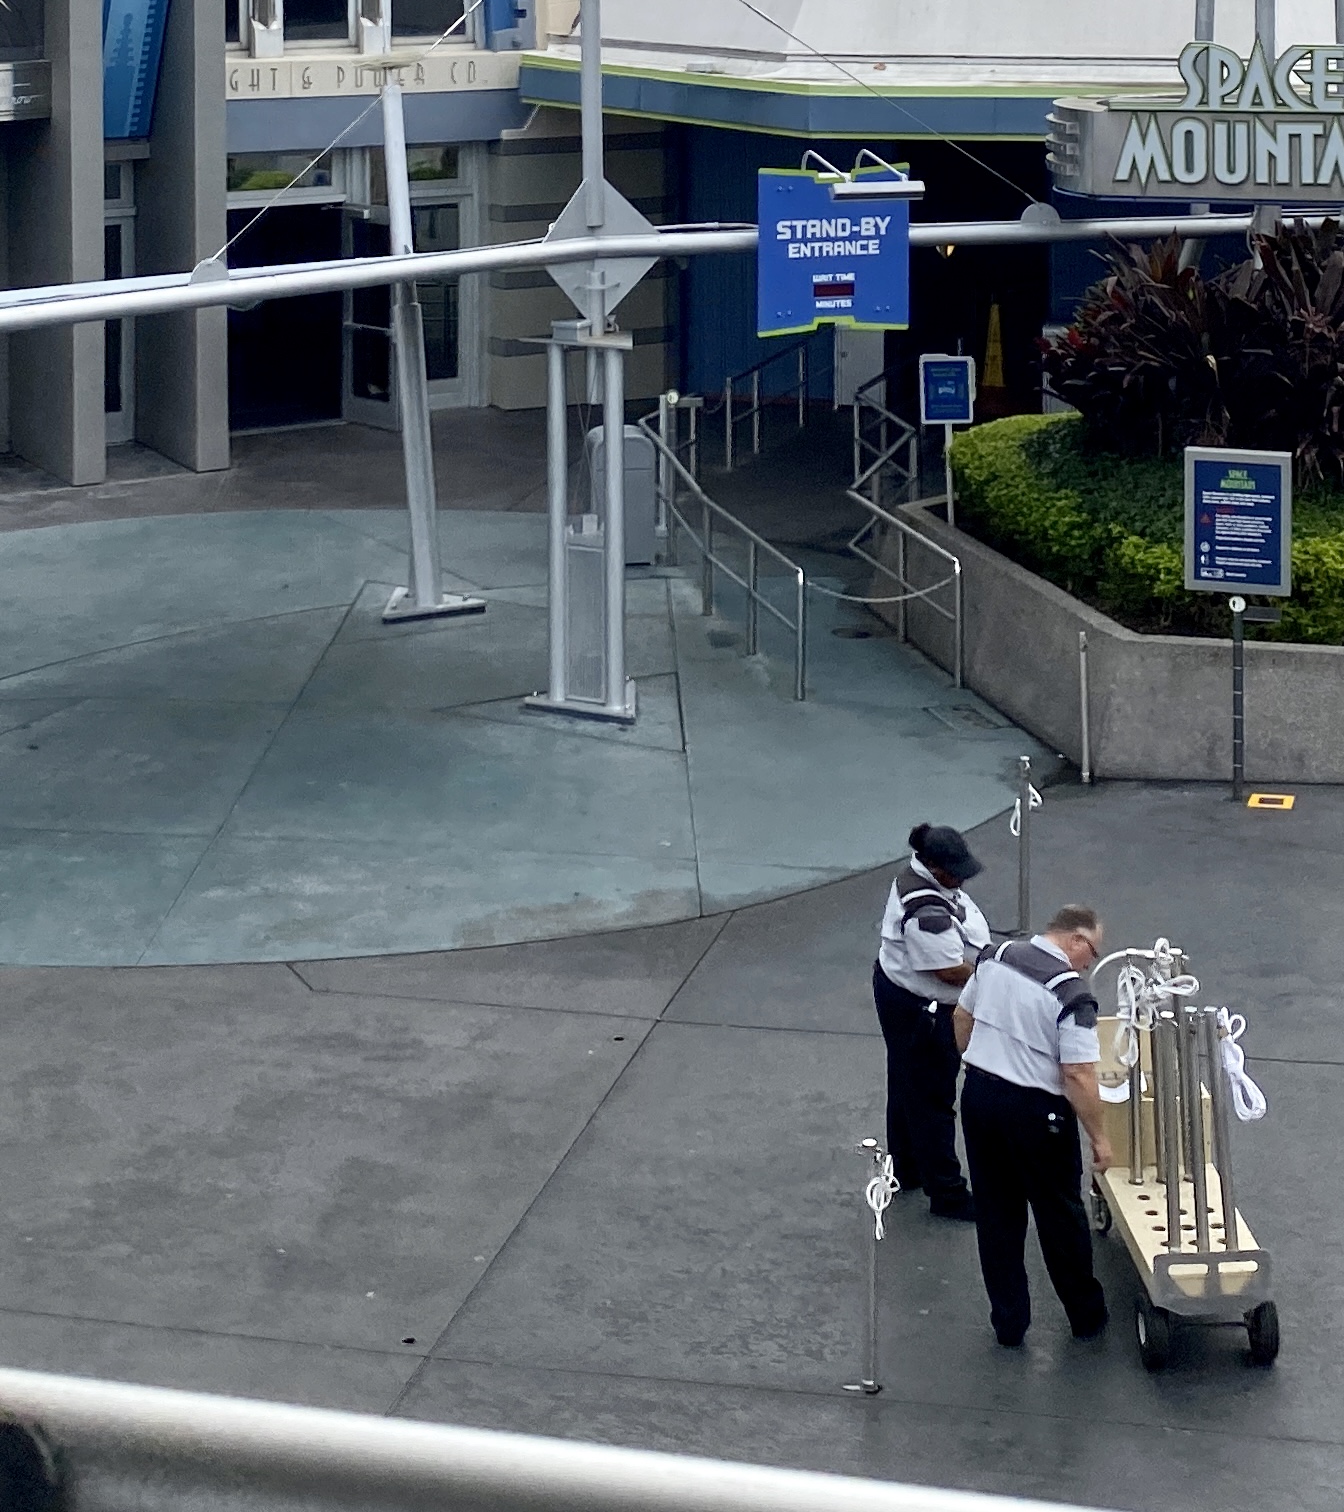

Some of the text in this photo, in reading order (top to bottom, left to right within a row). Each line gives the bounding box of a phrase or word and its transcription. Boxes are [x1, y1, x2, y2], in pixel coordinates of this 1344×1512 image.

[229, 67, 278, 92] GHT
[301, 66, 313, 90] &
[776, 215, 892, 240] STAND-BY
[788, 239, 880, 259] ENTRANCE
